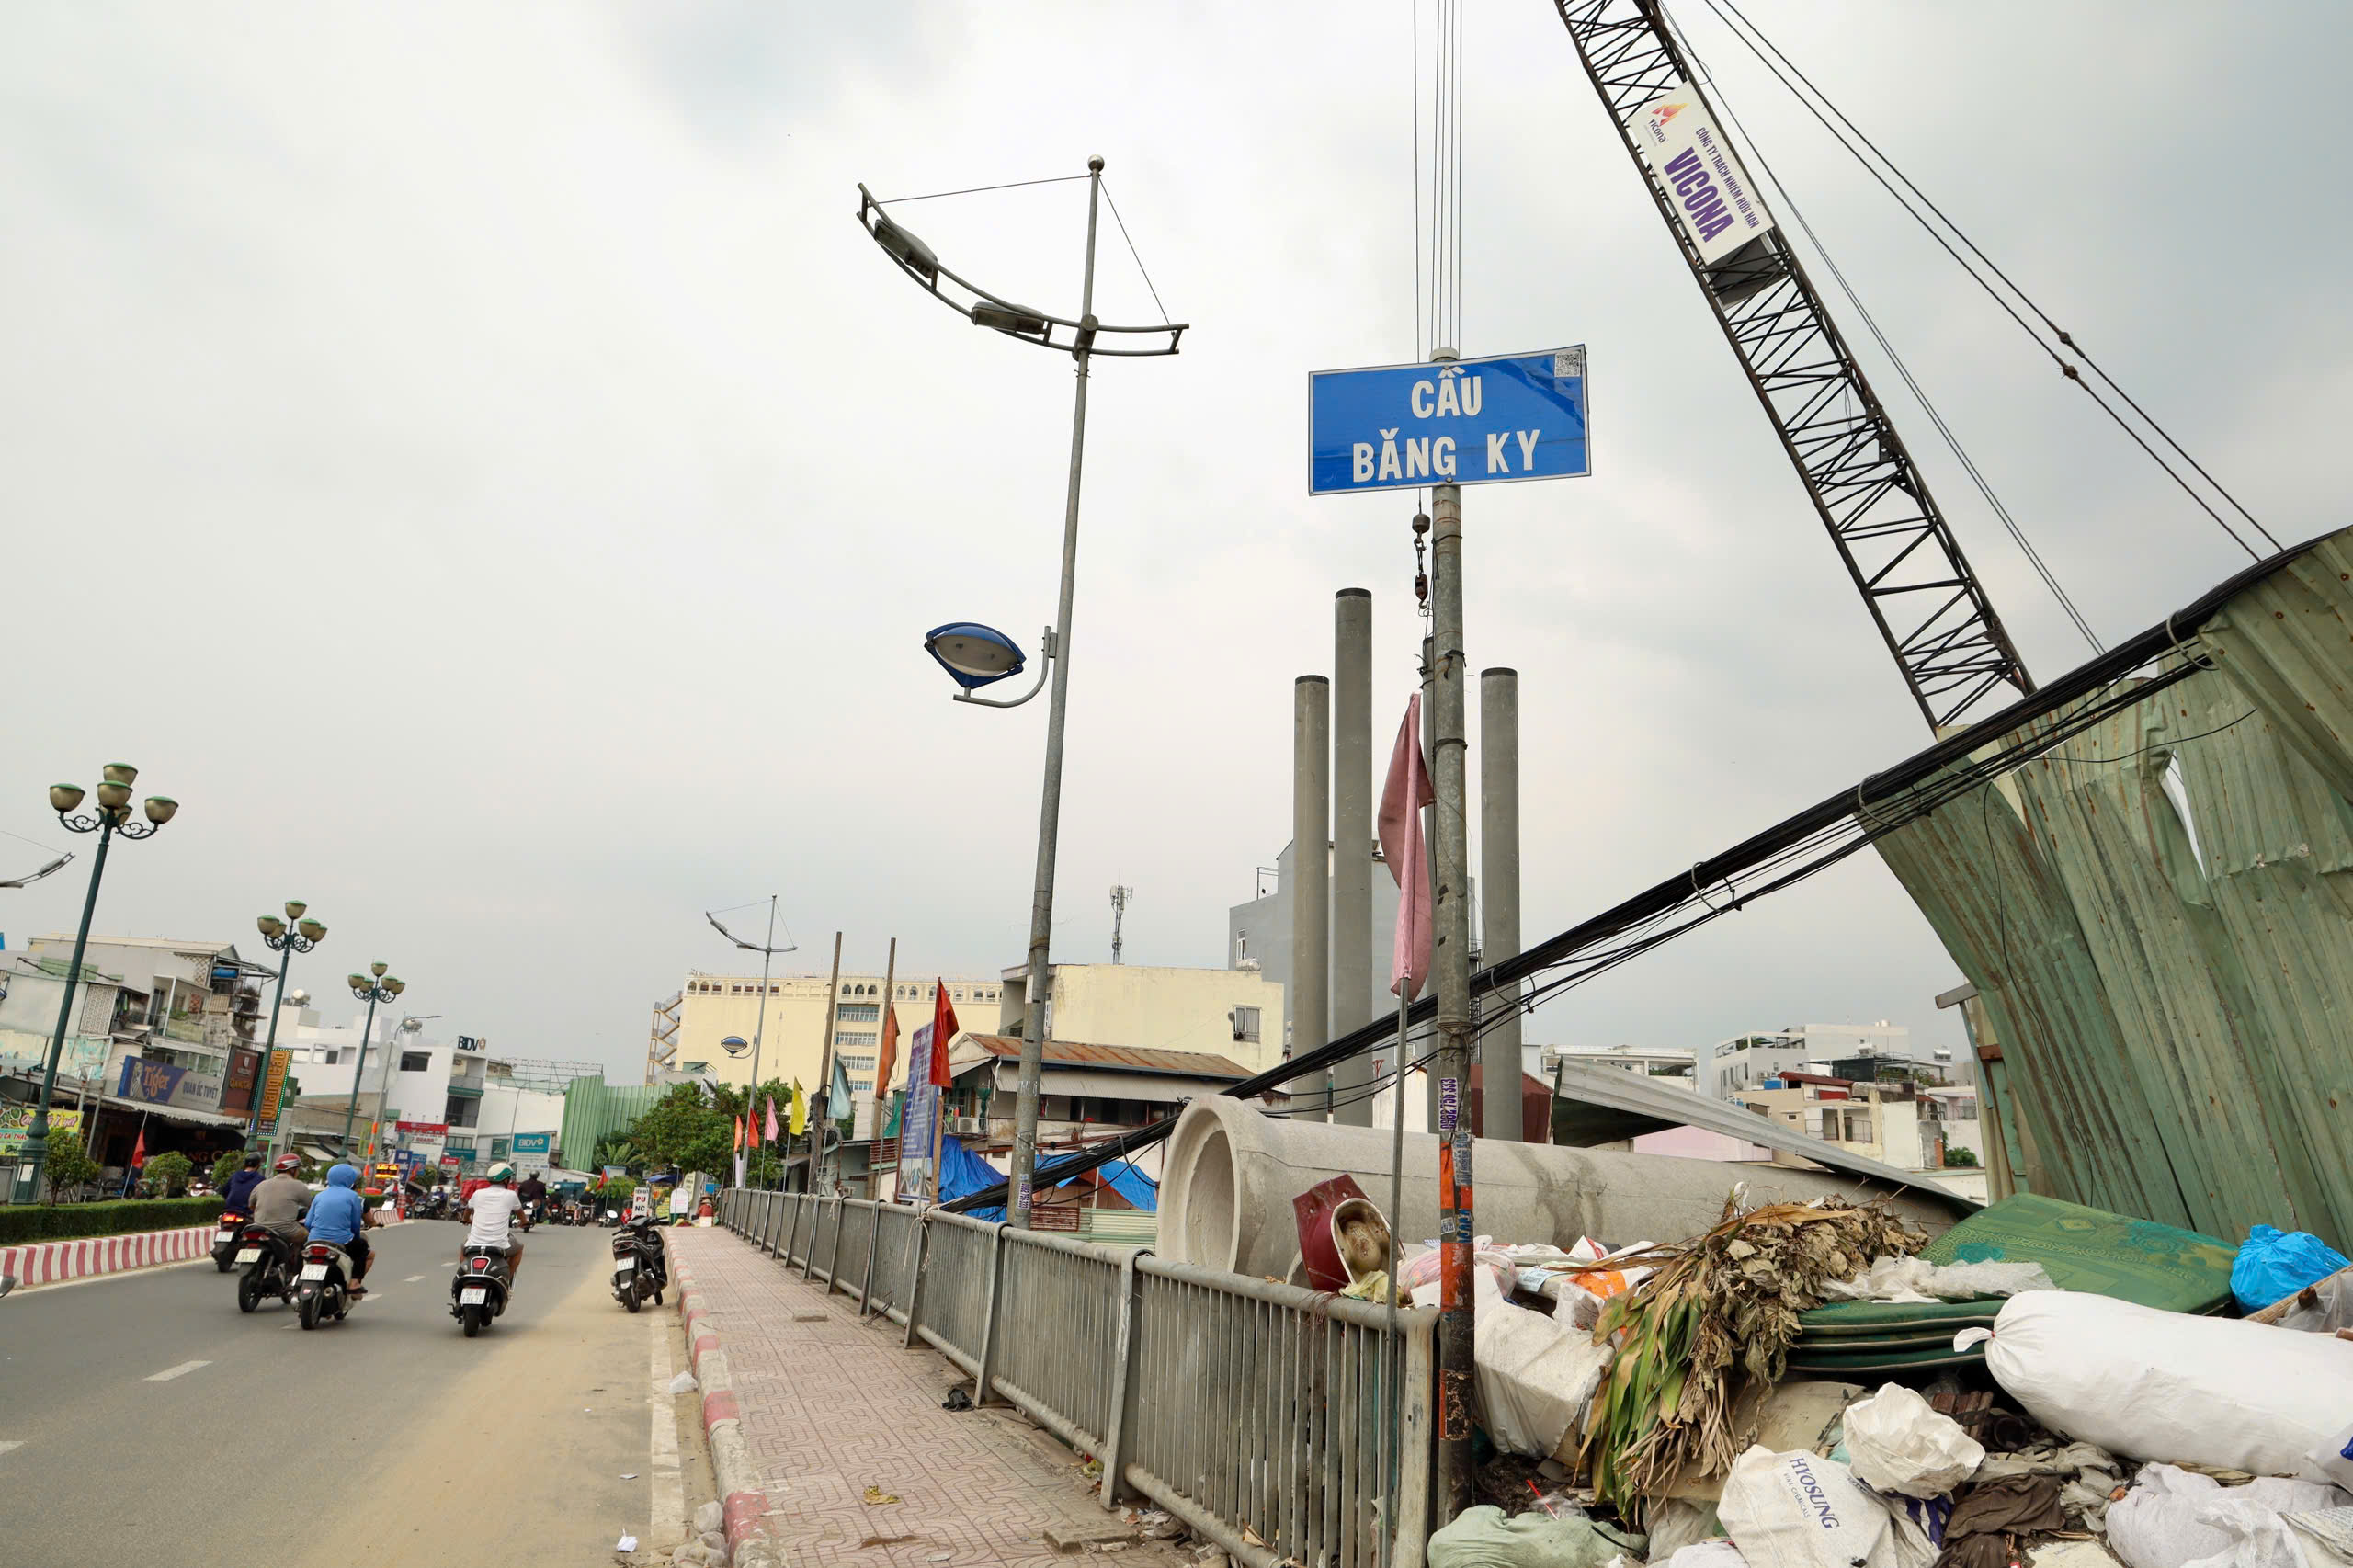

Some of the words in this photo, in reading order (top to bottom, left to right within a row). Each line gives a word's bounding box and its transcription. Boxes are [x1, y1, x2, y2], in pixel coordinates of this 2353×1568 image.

[1707, 144, 1718, 156] TY
[1664, 147, 1735, 244] VICONA
[1411, 366, 1482, 418] CẦU
[1353, 427, 1456, 483] BĂNG
[1487, 429, 1540, 473] KY
[458, 1035, 479, 1051] BIDV
[143, 1066, 170, 1096] Tiger
[1789, 1457, 1840, 1529] HYOSUNG
